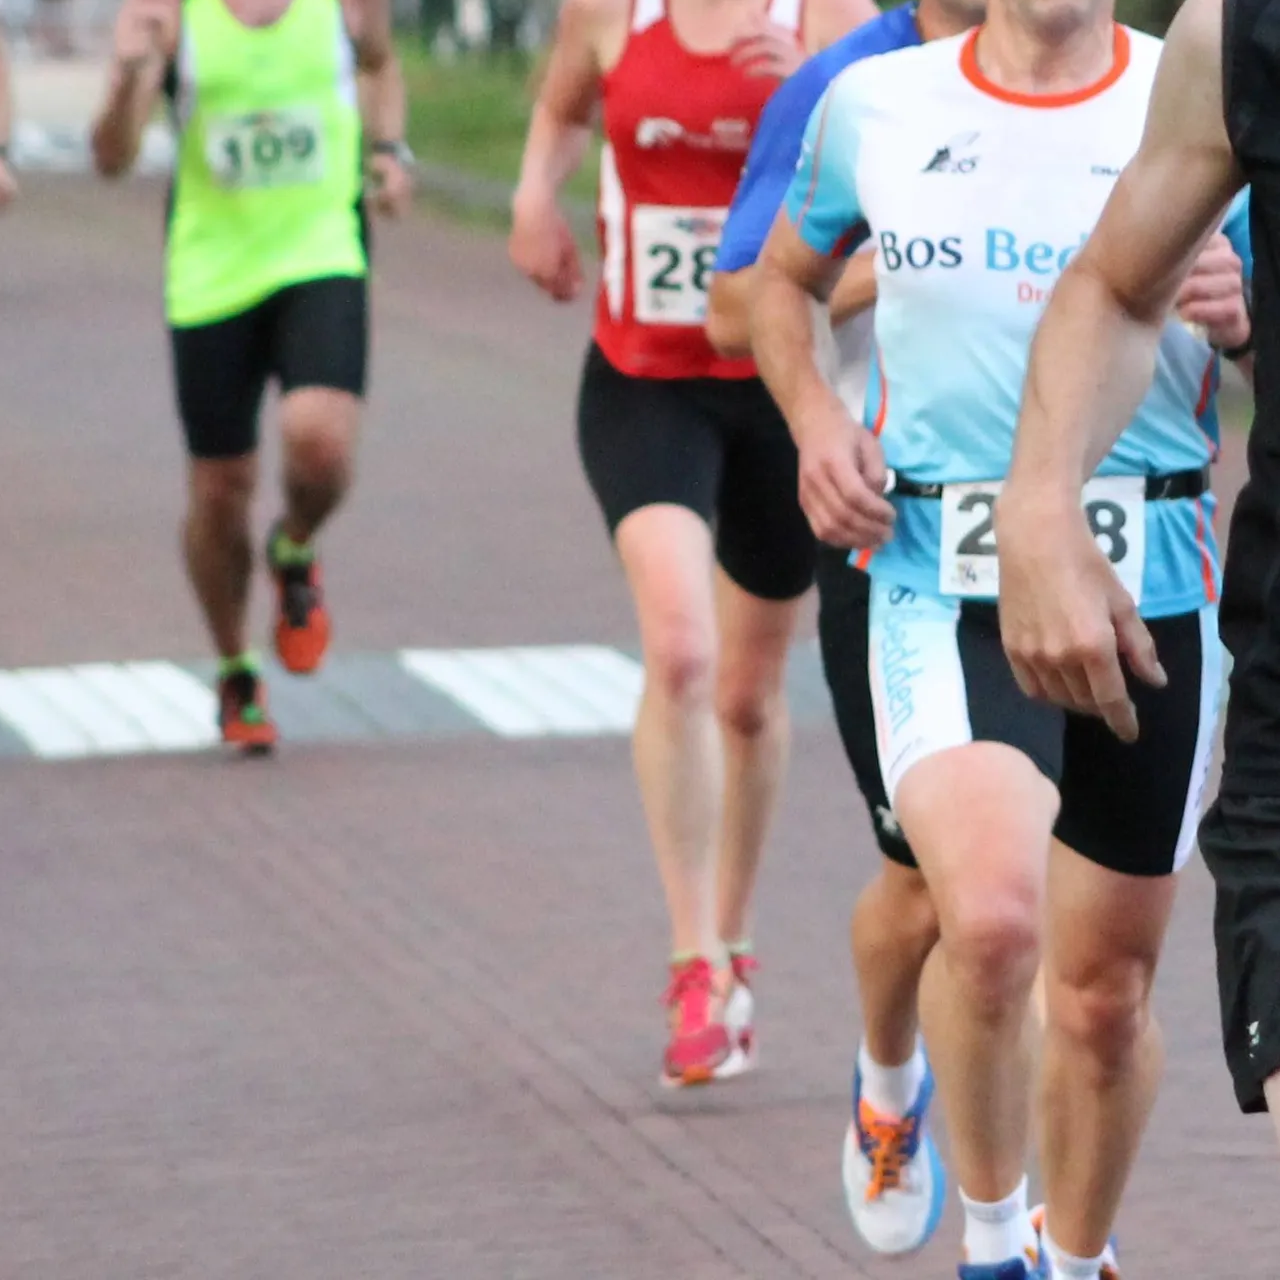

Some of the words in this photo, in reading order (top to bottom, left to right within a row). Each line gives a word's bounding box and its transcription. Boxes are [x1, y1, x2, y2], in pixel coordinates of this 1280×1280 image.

[222, 125, 318, 173] 109
[880, 230, 964, 272] Bos
[956, 491, 1128, 564] 28
